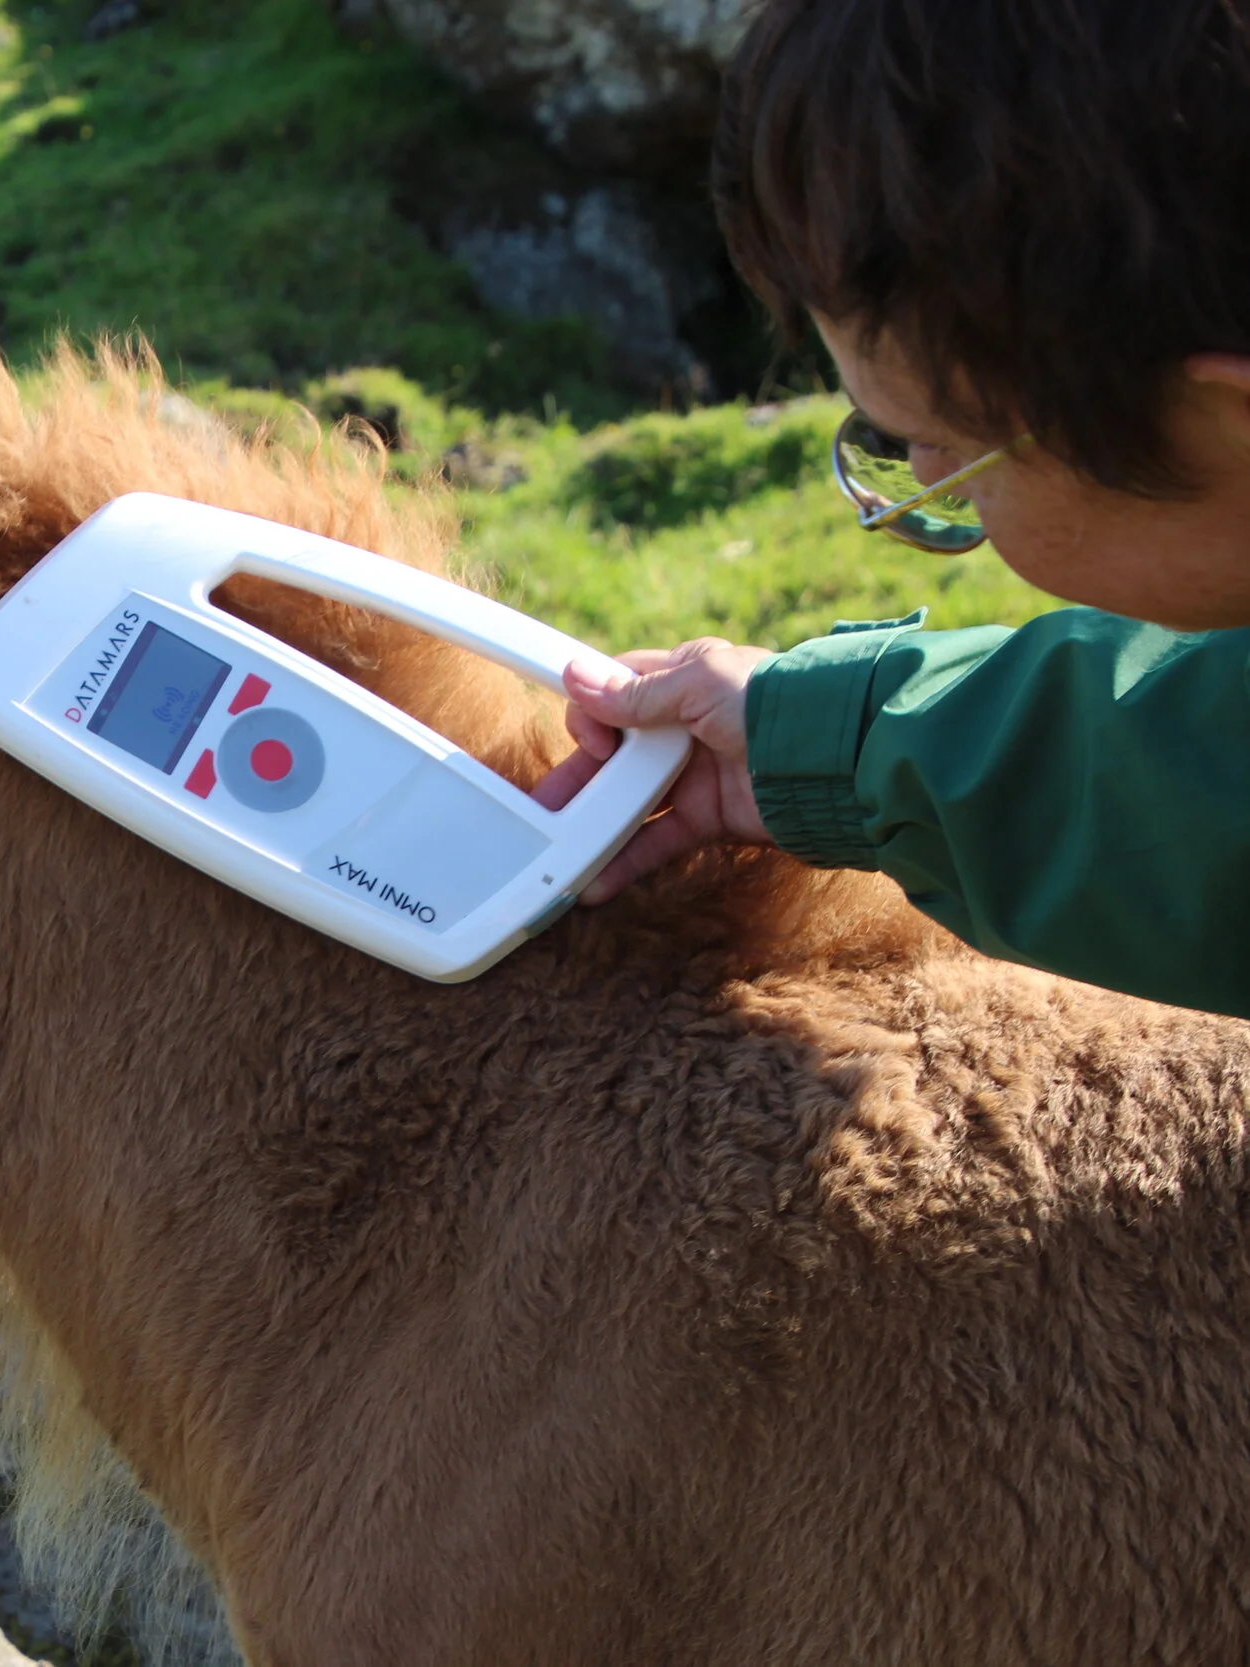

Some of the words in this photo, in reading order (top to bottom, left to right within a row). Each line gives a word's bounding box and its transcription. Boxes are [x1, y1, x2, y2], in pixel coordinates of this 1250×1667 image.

[64, 609, 140, 724] DATAMARS
[168, 689, 200, 736] READING
[328, 853, 379, 893] MAX
[378, 883, 436, 924] OMNI
